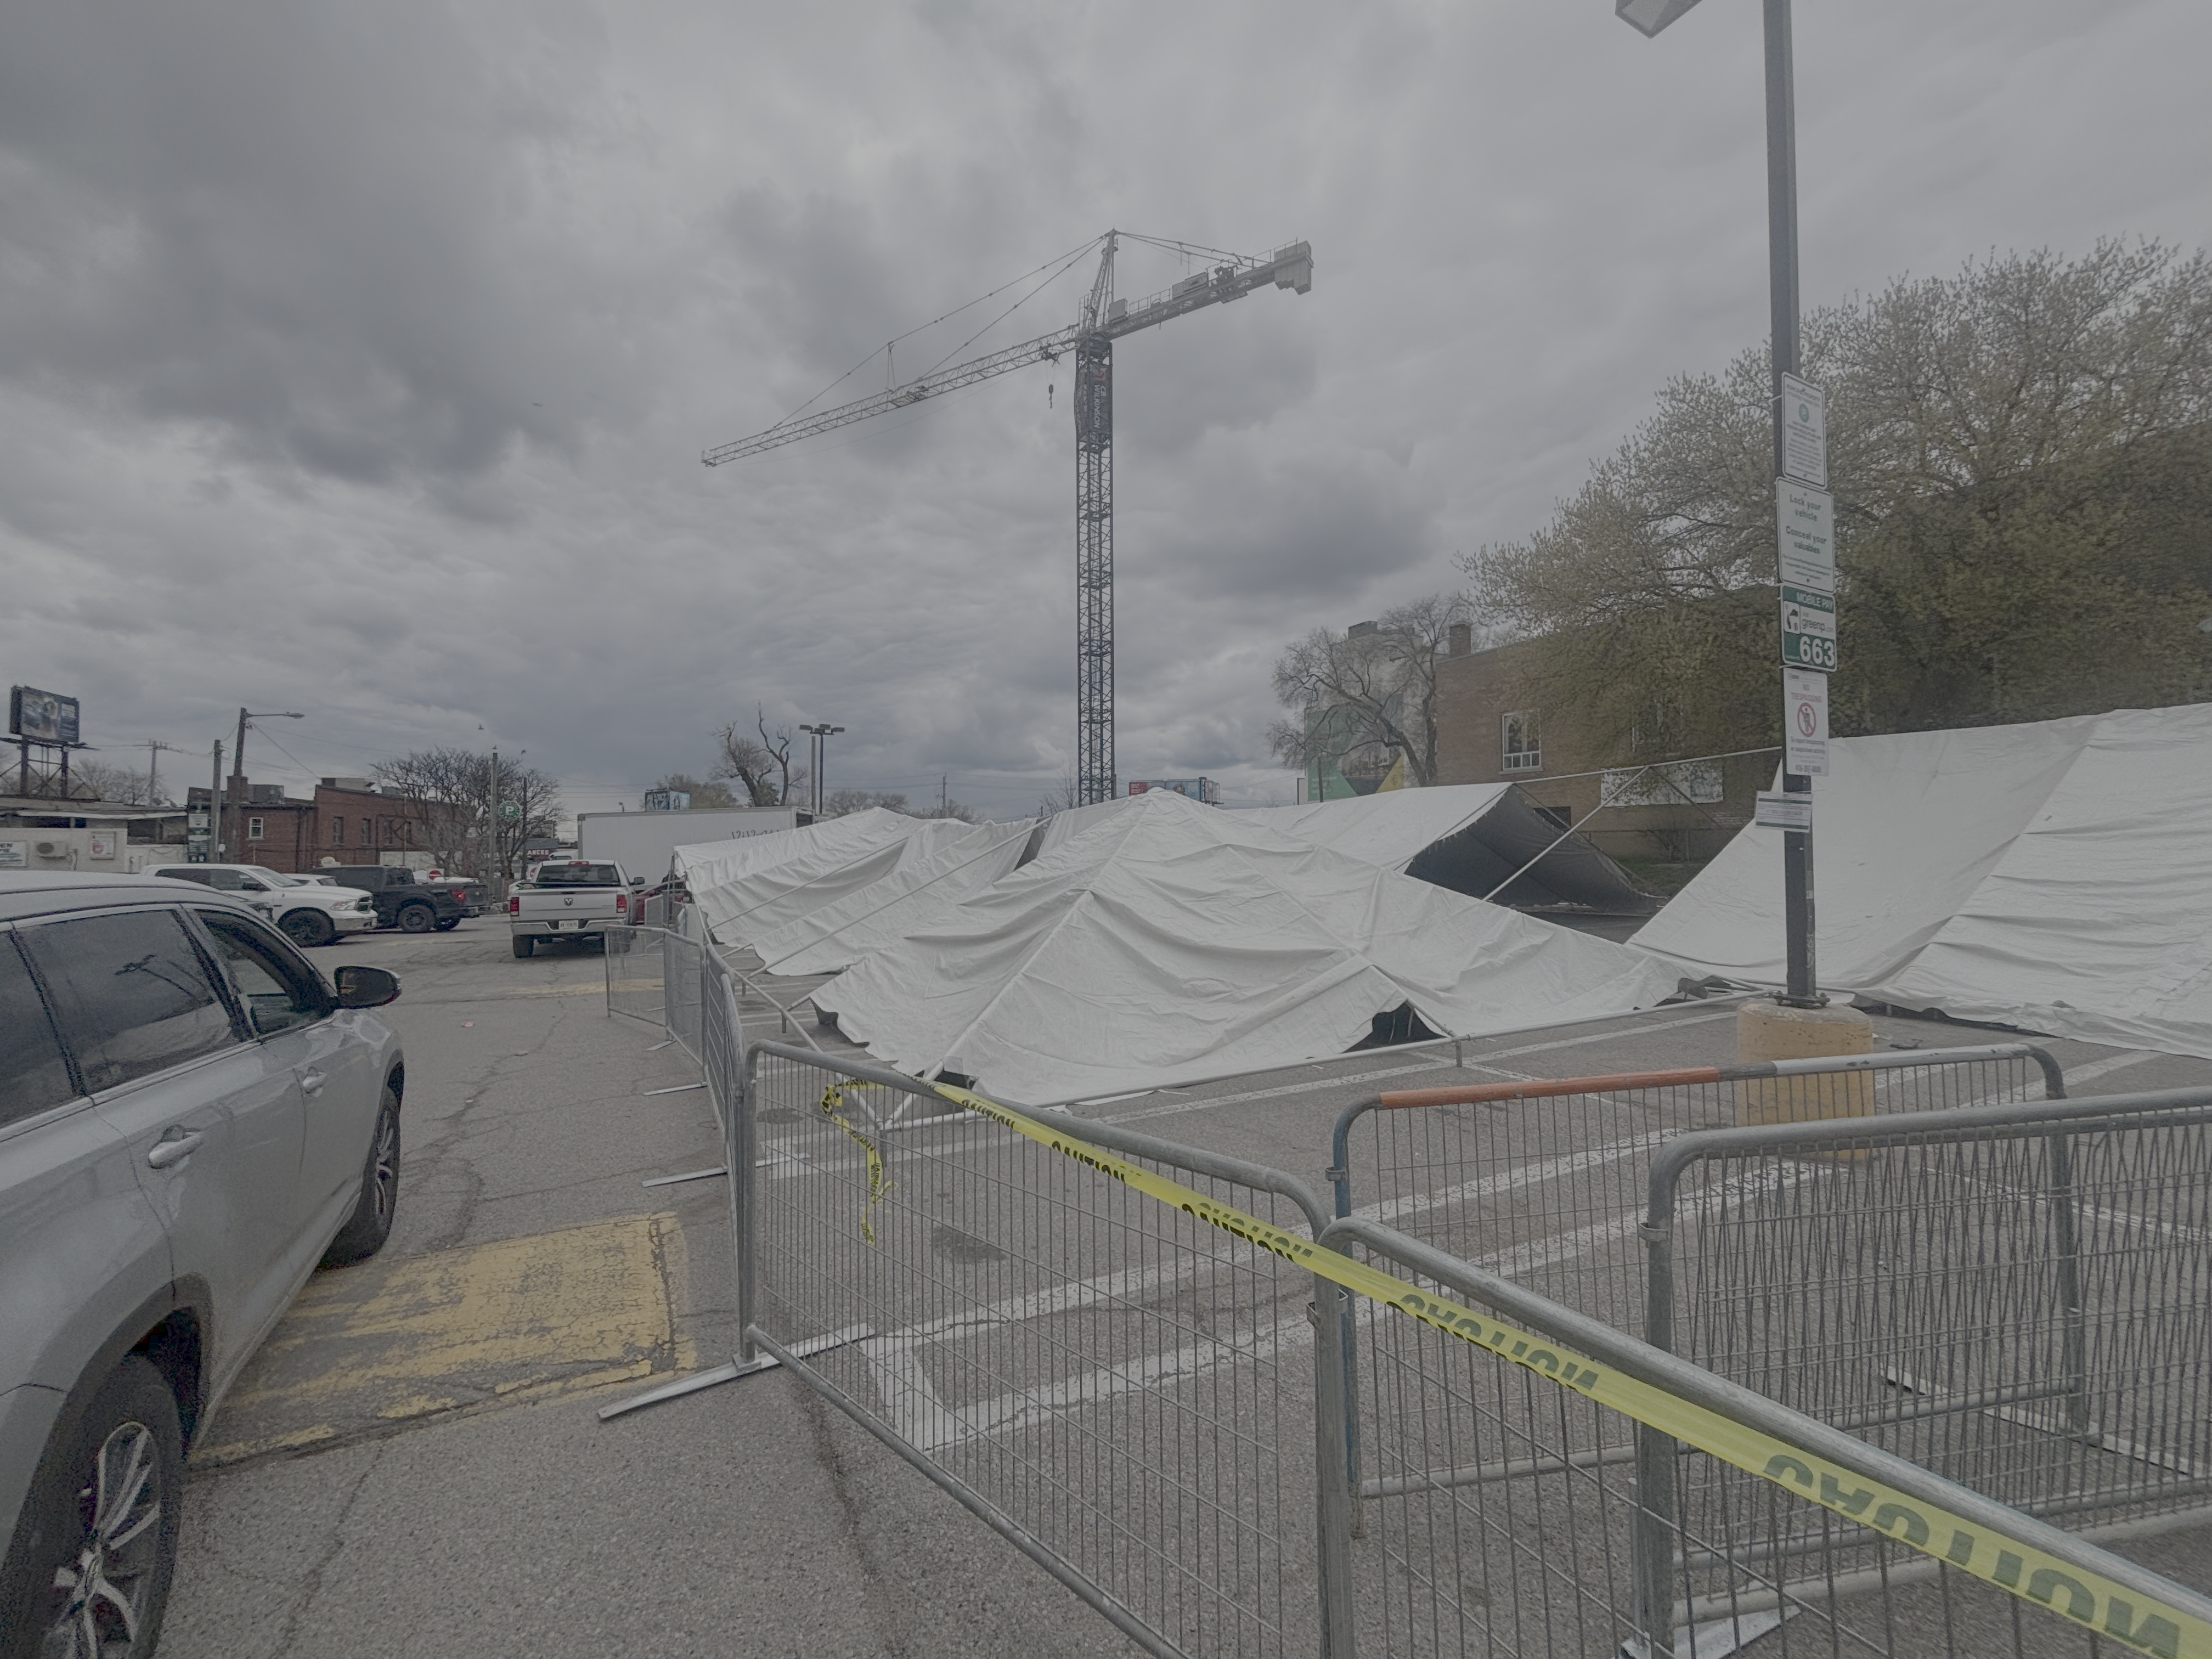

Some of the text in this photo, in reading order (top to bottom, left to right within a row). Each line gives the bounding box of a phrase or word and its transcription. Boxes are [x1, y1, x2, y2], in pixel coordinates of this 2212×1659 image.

[1790, 494, 1821, 511] Lock your
[1795, 509, 1818, 521] vehicle
[1786, 525, 1827, 545] Conceal your
[1794, 541, 1820, 554] valuables
[1796, 592, 1833, 611] MOBILE PAY
[1799, 635, 1835, 667] 663
